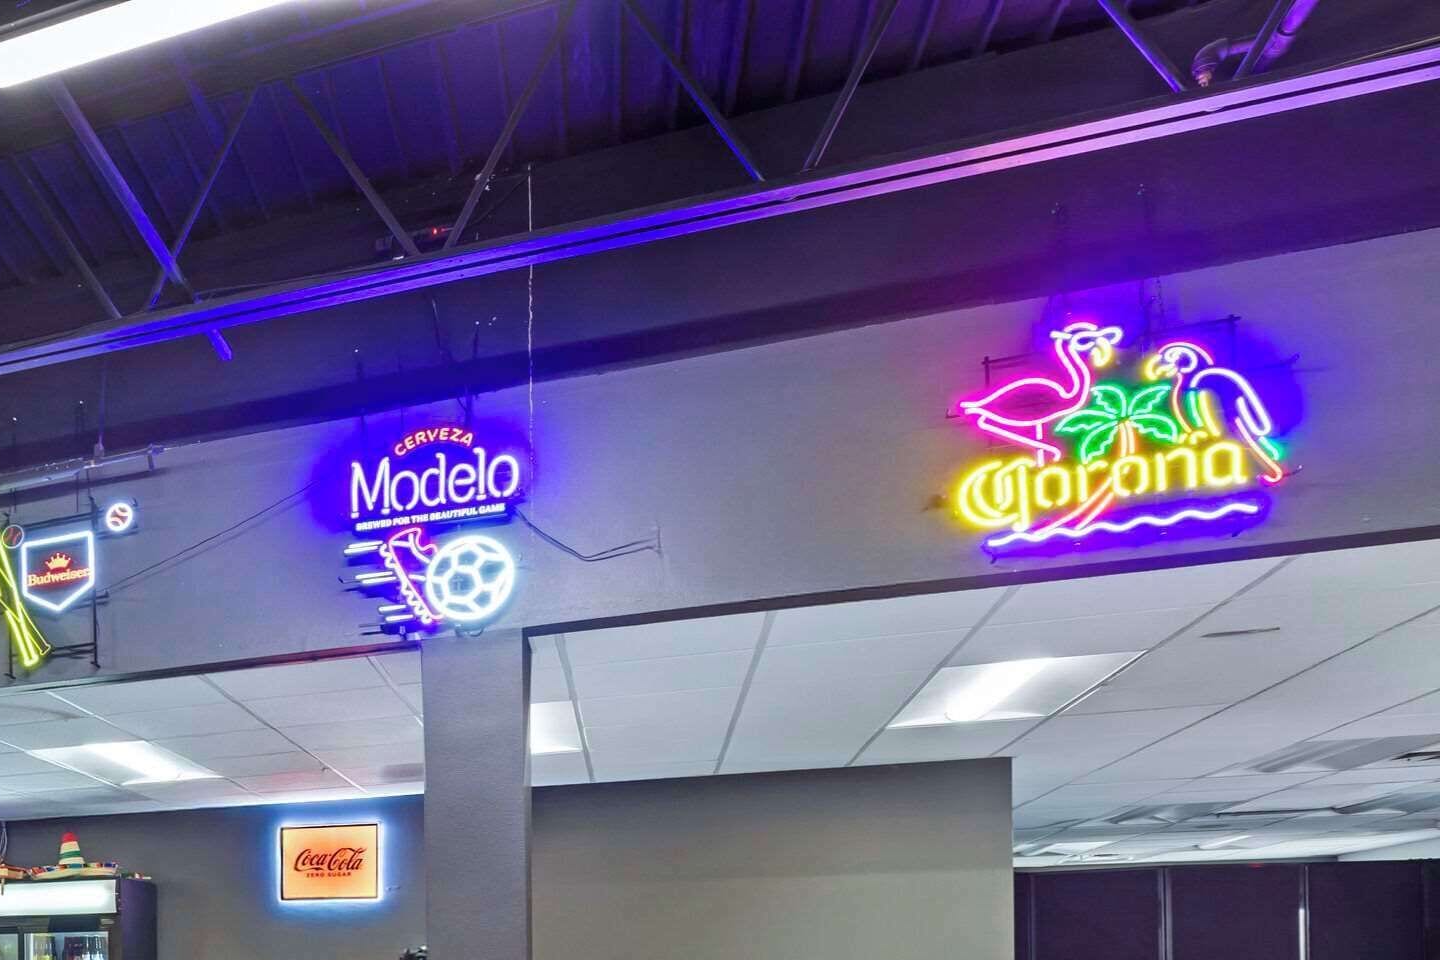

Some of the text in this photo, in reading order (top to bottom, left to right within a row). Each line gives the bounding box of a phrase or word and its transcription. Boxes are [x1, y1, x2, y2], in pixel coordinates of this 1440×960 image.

[394, 427, 474, 456] CERVEZA
[350, 447, 520, 519] Modelo
[959, 441, 1248, 532] Corona
[356, 503, 506, 531] BREWED FOR THE BEAUTIFUL GAME
[28, 568, 92, 586] Budweiser
[294, 847, 368, 872] Coca-Cola
